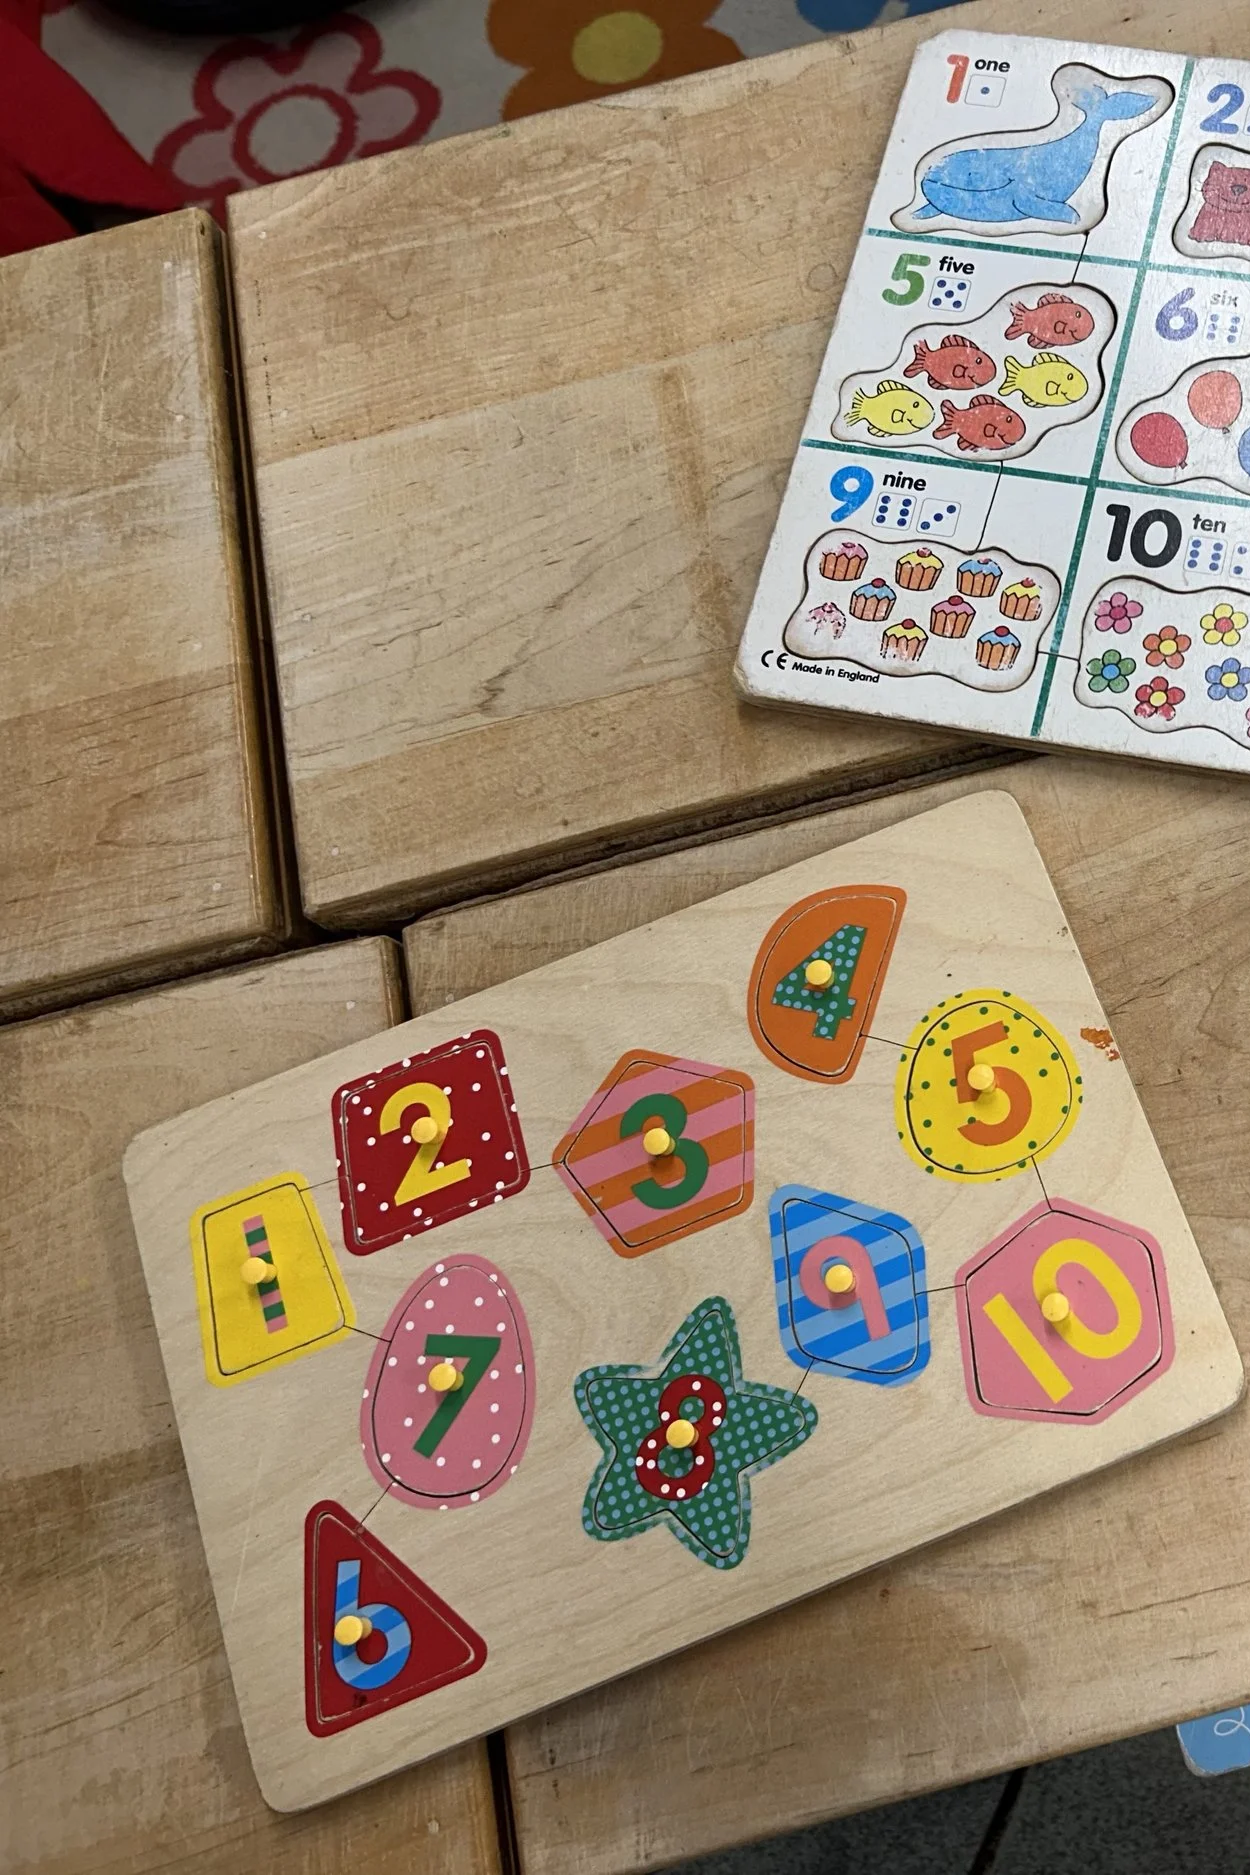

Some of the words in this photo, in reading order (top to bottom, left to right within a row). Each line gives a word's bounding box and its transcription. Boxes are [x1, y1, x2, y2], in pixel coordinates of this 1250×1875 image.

[946, 54, 970, 104] 1
[974, 56, 1011, 74] one
[1200, 83, 1244, 135] 2
[881, 253, 931, 306] 5
[938, 256, 976, 277] five
[1155, 287, 1198, 341] 6
[1210, 290, 1239, 308] six
[829, 465, 874, 522] 9
[882, 472, 927, 492] nine
[1105, 503, 1182, 567] 10
[1193, 514, 1227, 534] ten
[791, 662, 823, 675] Made
[825, 666, 835, 677] in
[837, 669, 880, 684] England
[773, 924, 867, 1041] 4
[950, 1019, 1032, 1146] 5
[379, 1081, 471, 1206] 2
[620, 1093, 709, 1210] 3
[242, 1214, 288, 1334] 1
[799, 1235, 892, 1341] 9
[982, 1238, 1143, 1405] 10
[412, 1334, 502, 1459] 7
[635, 1374, 727, 1500] 8
[332, 1559, 412, 1690] 6
